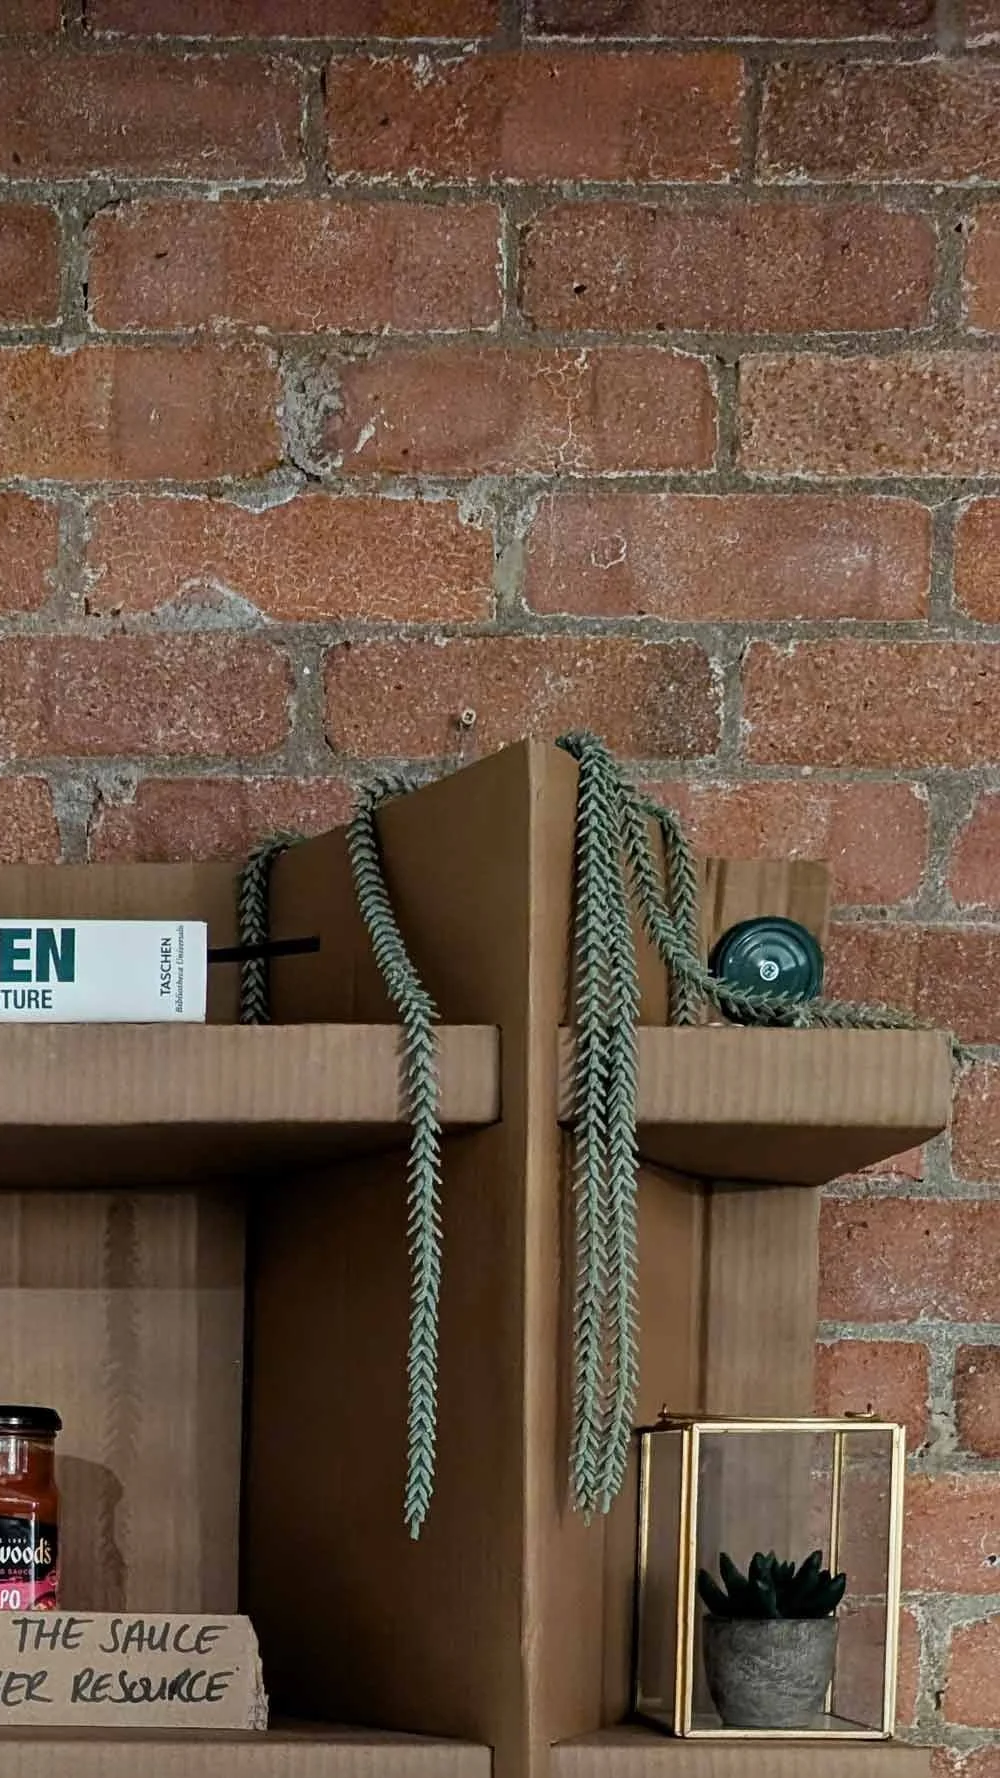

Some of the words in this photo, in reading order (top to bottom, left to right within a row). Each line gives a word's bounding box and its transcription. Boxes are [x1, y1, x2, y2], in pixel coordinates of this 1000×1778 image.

[160, 937, 172, 997] TASCHEN
[0, 1589, 21, 1609] PO
[12, 1617, 94, 1653] THE
[99, 1618, 229, 1654] SAUCE
[70, 1667, 235, 1704] RESOURCE
